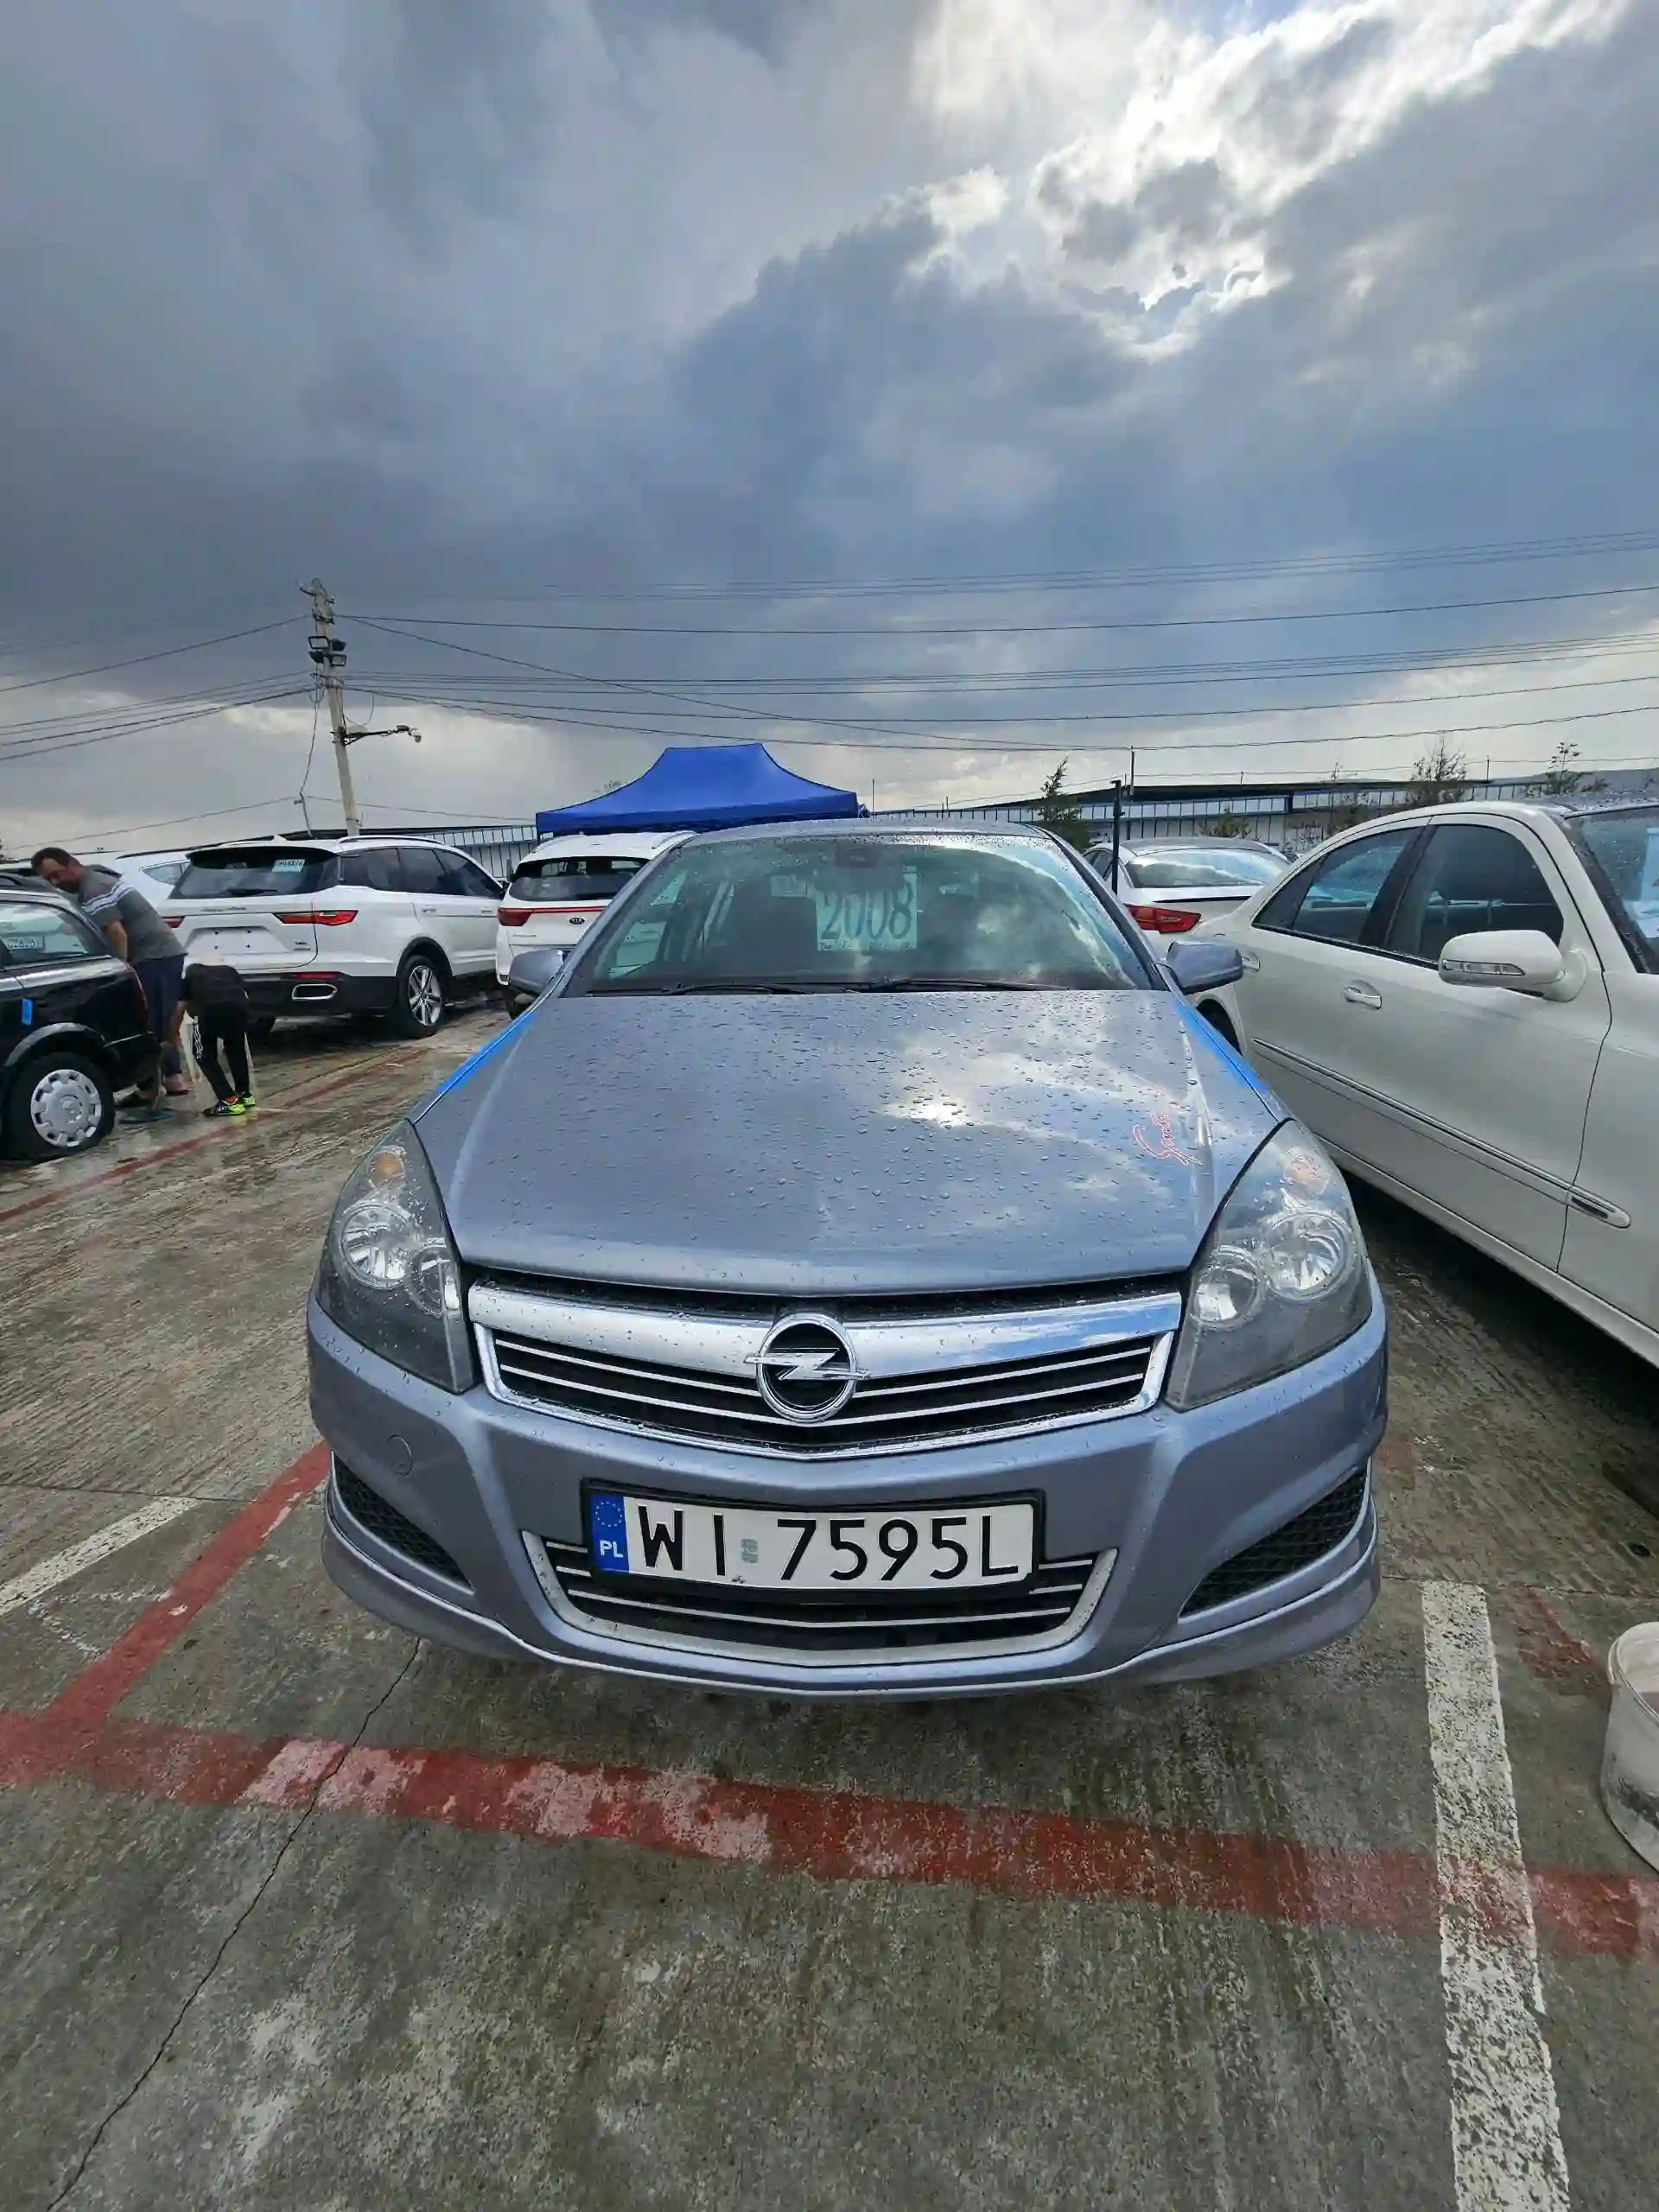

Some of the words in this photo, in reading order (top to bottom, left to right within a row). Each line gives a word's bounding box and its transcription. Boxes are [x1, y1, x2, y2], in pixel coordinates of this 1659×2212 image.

[822, 880, 913, 939] 2008
[599, 1540, 623, 1558] PL
[638, 1504, 726, 1577] WI
[778, 1515, 1019, 1581] 7595L
